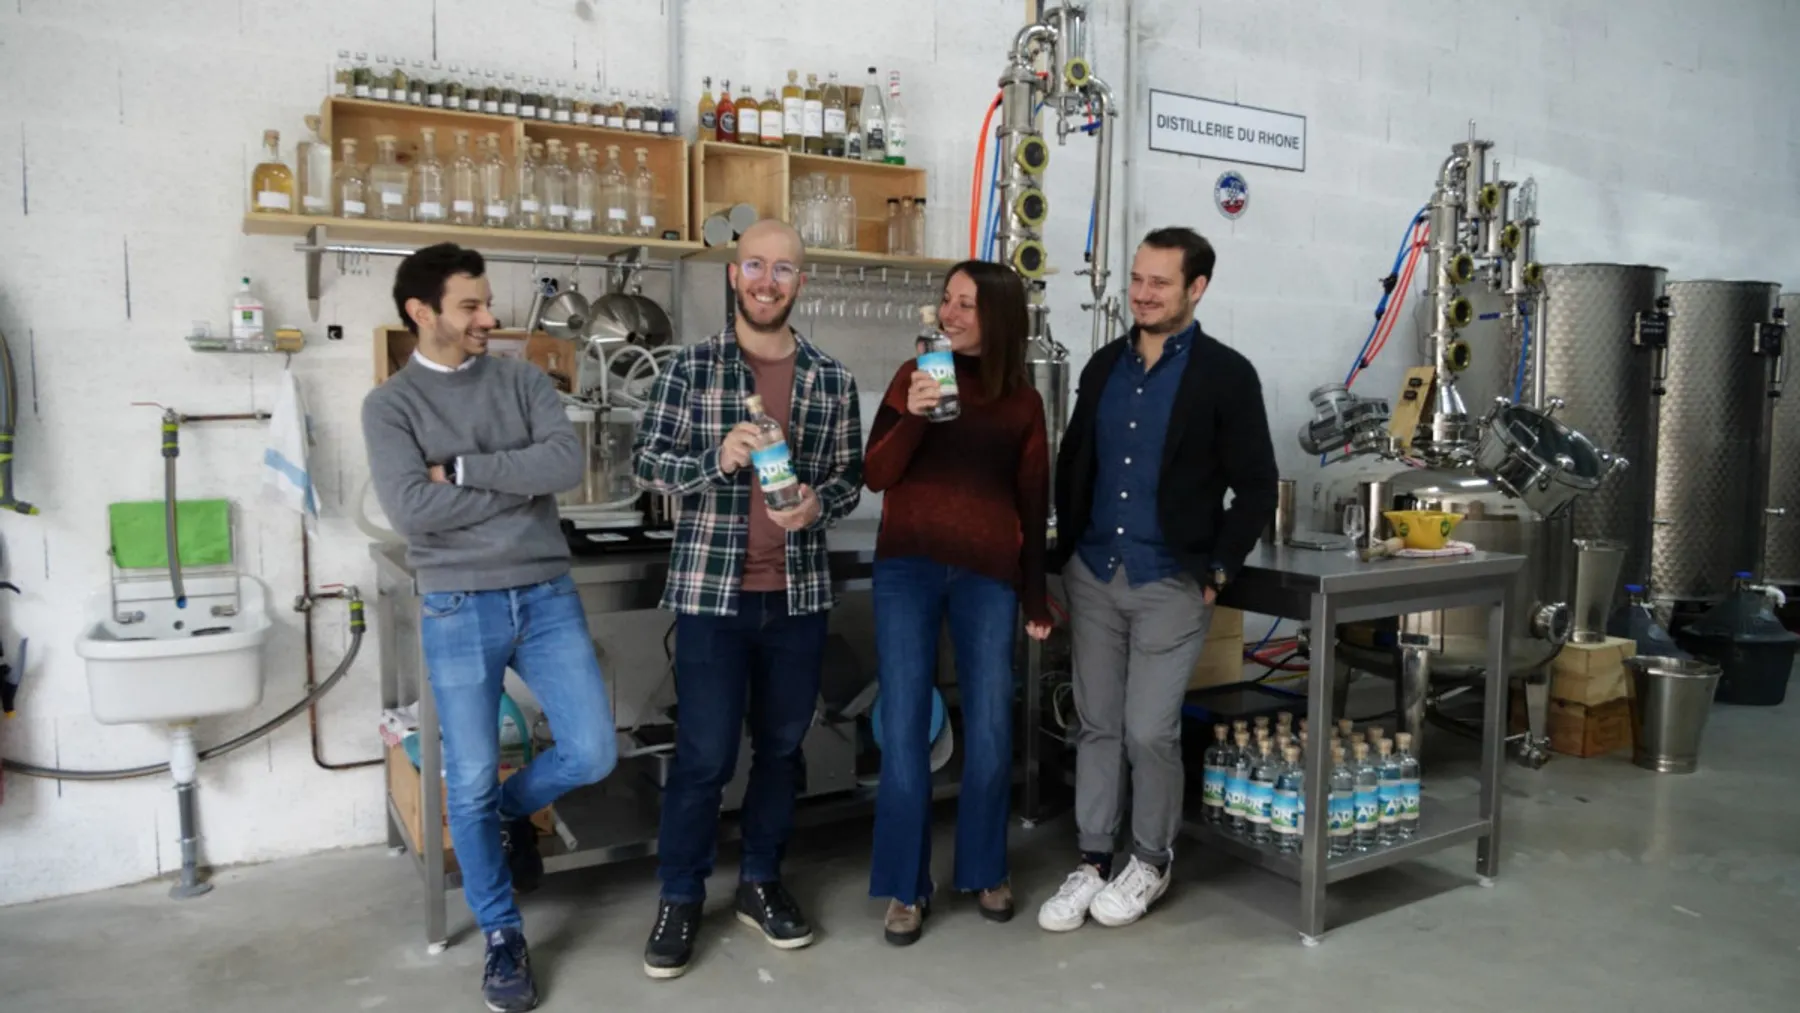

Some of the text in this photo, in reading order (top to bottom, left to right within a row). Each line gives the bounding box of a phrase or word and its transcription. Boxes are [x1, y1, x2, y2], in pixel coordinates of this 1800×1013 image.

[1156, 113, 1300, 150] DISTILLERIE DU RHONE
